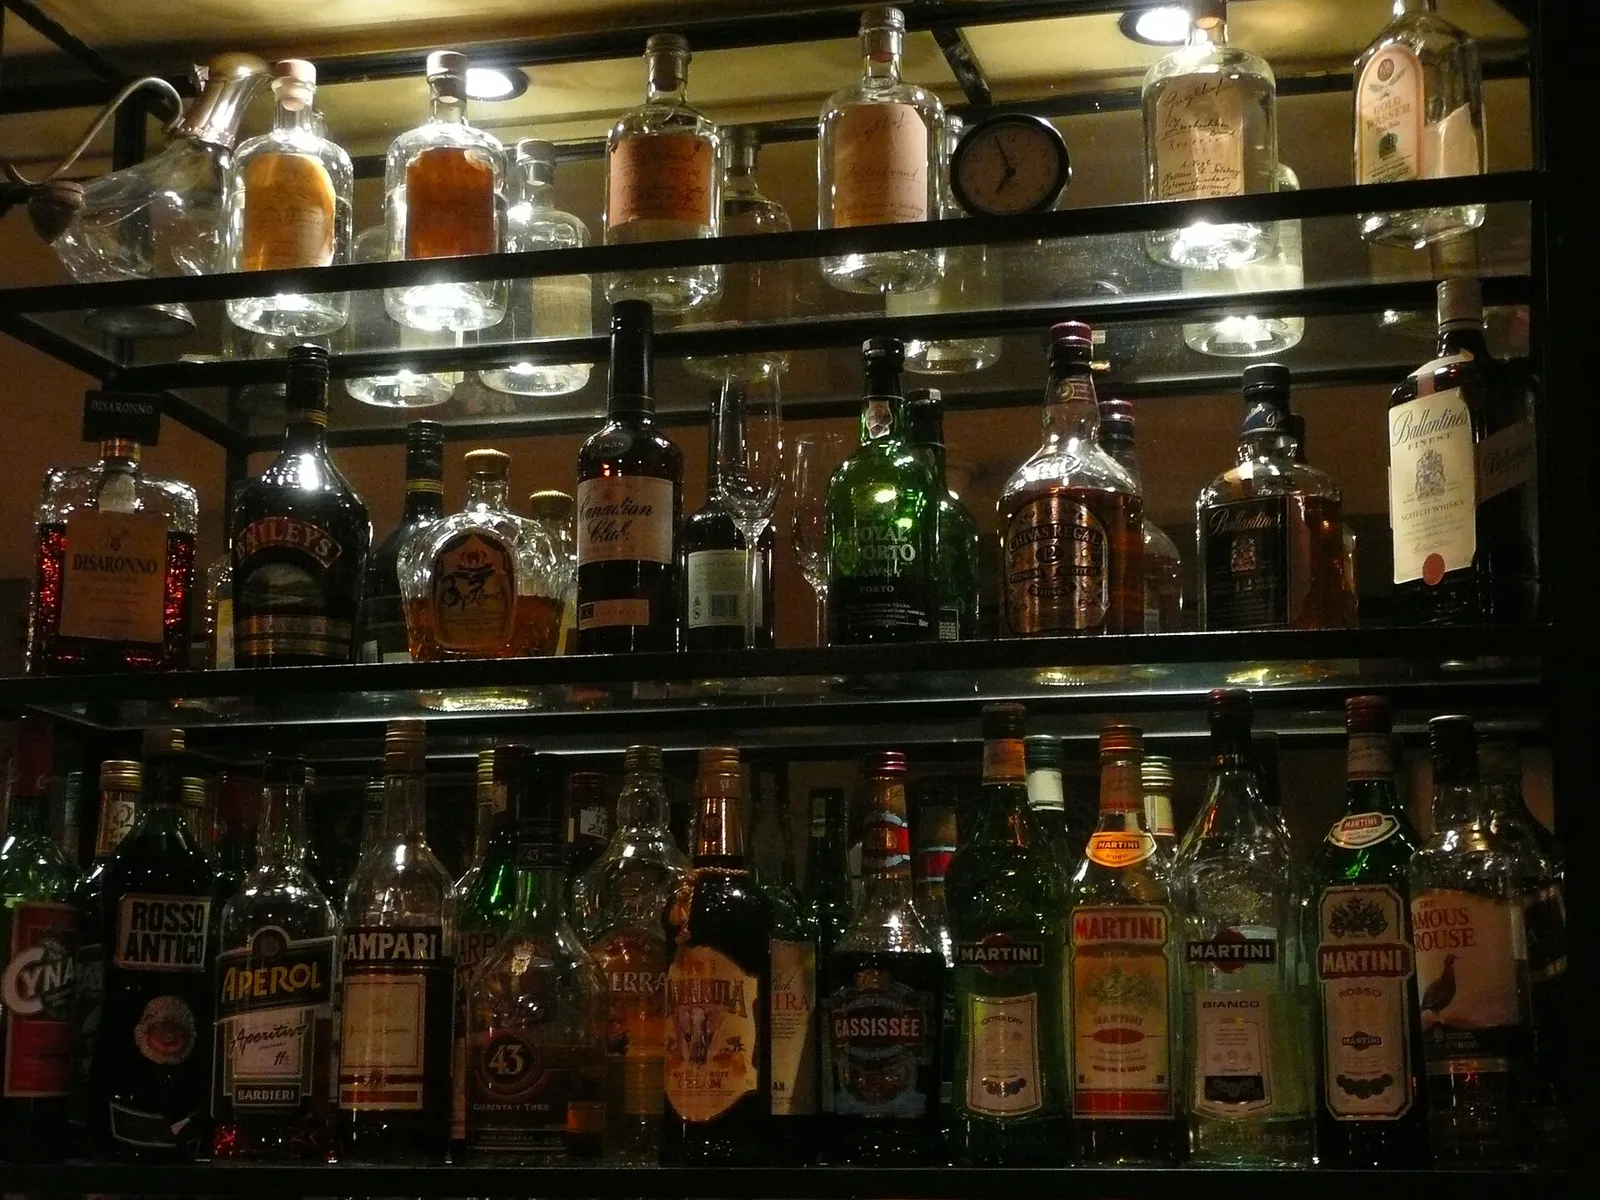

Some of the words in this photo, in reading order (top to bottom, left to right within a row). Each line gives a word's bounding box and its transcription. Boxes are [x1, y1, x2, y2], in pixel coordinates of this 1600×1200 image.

[91, 400, 154, 415] DISARONNO
[1407, 431, 1454, 451] FINEST
[1400, 507, 1432, 521] SCOTCH
[1431, 499, 1466, 515] WHISKY
[235, 520, 334, 558] BAILEYS
[1008, 527, 1049, 552] CHIVAS
[1053, 524, 1101, 546] REGAL
[73, 553, 158, 575] DISARONNO
[1344, 817, 1378, 829] MARTINI
[1097, 841, 1139, 850] MARTINI
[131, 901, 205, 933] ROSSO
[1076, 916, 1162, 940] MARTINI
[1413, 906, 1470, 930] MOUS
[344, 932, 437, 960] AMPARI
[1414, 927, 1477, 952] ROUSE
[961, 946, 1039, 962] MARTINI
[1189, 944, 1271, 959] MARTINI
[1322, 949, 1404, 974] MARTINI
[3, 946, 76, 1014] CYNA
[221, 962, 322, 1004] APEROL
[1338, 986, 1383, 999] ROSSO
[1202, 1000, 1261, 1009] BIANCO
[835, 1014, 920, 1038] CASSISSÉE
[980, 1015, 1006, 1026] EXTRA
[1007, 1016, 1025, 1026] DRY
[488, 1044, 525, 1076] 43
[237, 1088, 295, 1102] BARBIERI
